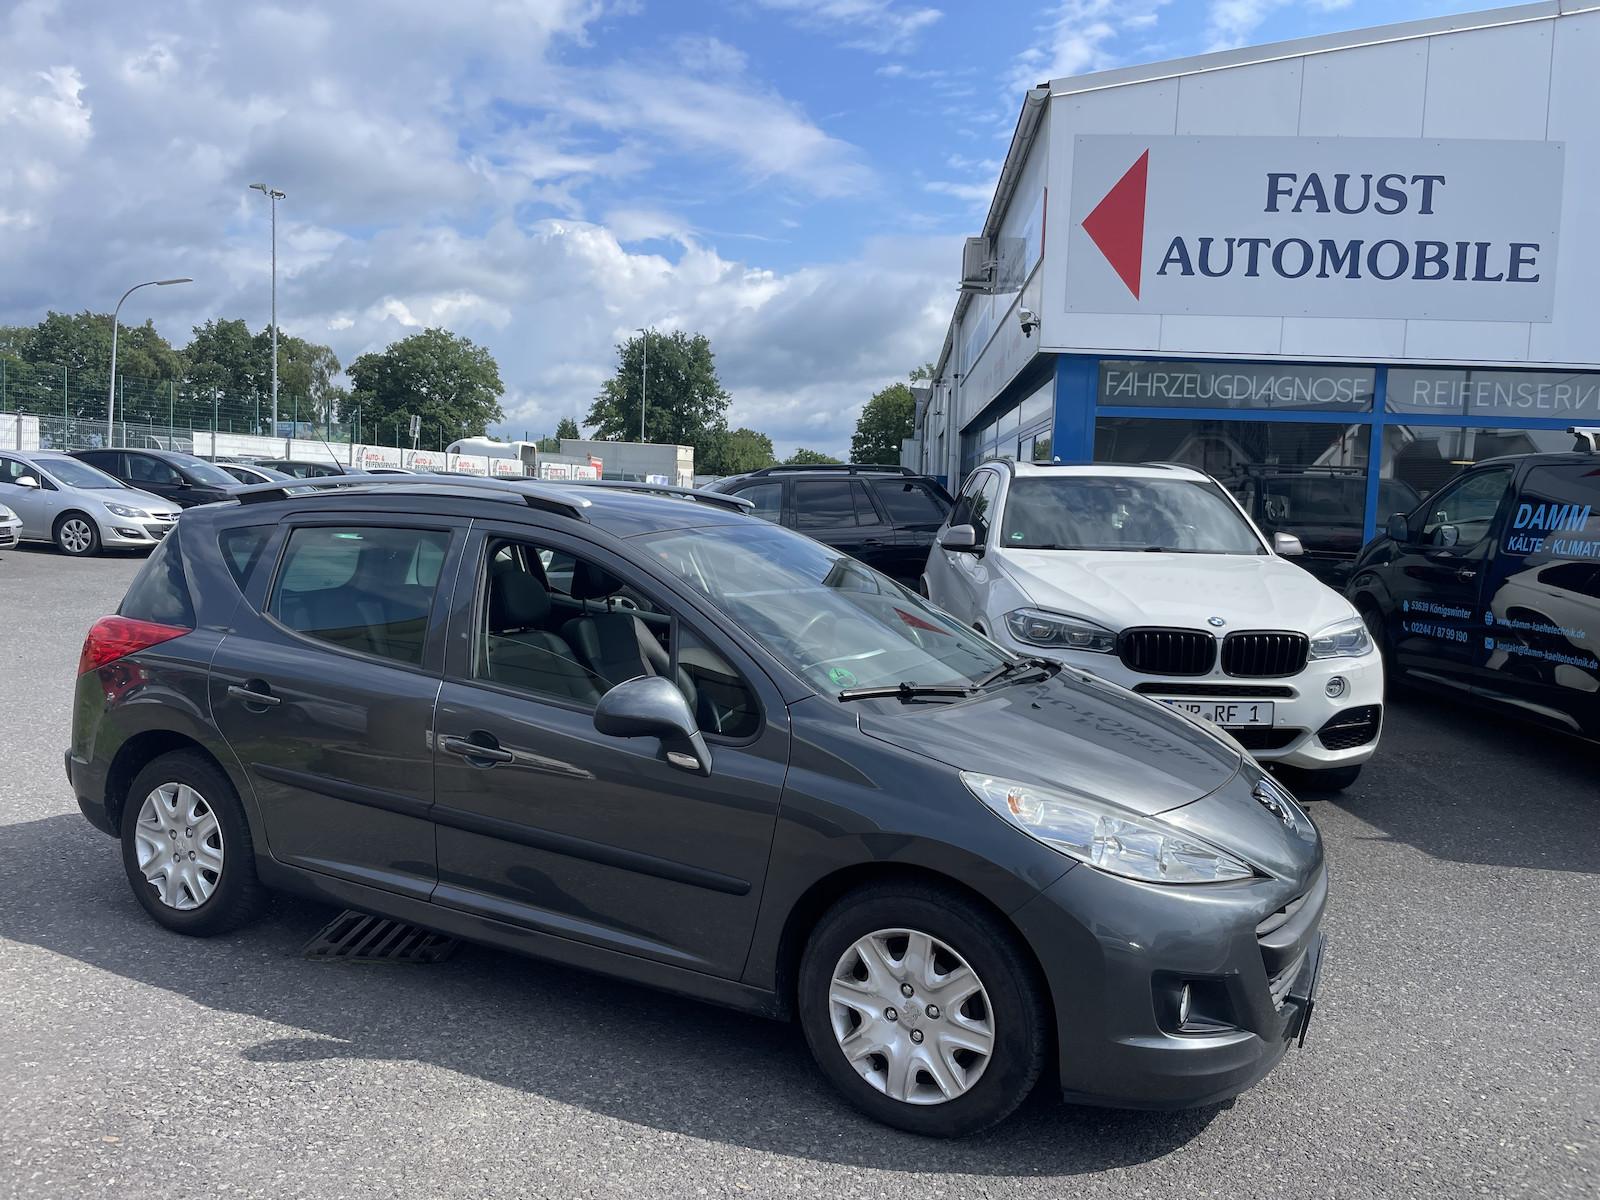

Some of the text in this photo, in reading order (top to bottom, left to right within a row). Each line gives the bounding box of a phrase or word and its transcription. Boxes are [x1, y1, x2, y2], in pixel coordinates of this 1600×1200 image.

[1264, 173, 1446, 215] FAUST
[1156, 236, 1541, 283] AUTOMOBILE
[1105, 371, 1369, 404] FAHRZEUGDIAGNOSE
[1513, 503, 1592, 532] DAMM
[1507, 533, 1544, 553] KÄLTE
[1551, 538, 1600, 559] KLIMAT
[1429, 602, 1472, 619] Königswinter
[1411, 622, 1431, 635] 02244
[1496, 617, 1586, 639] www.damm-kaeltetechnik.de
[1214, 705, 1239, 722] RF
[1248, 705, 1259, 722] 1
